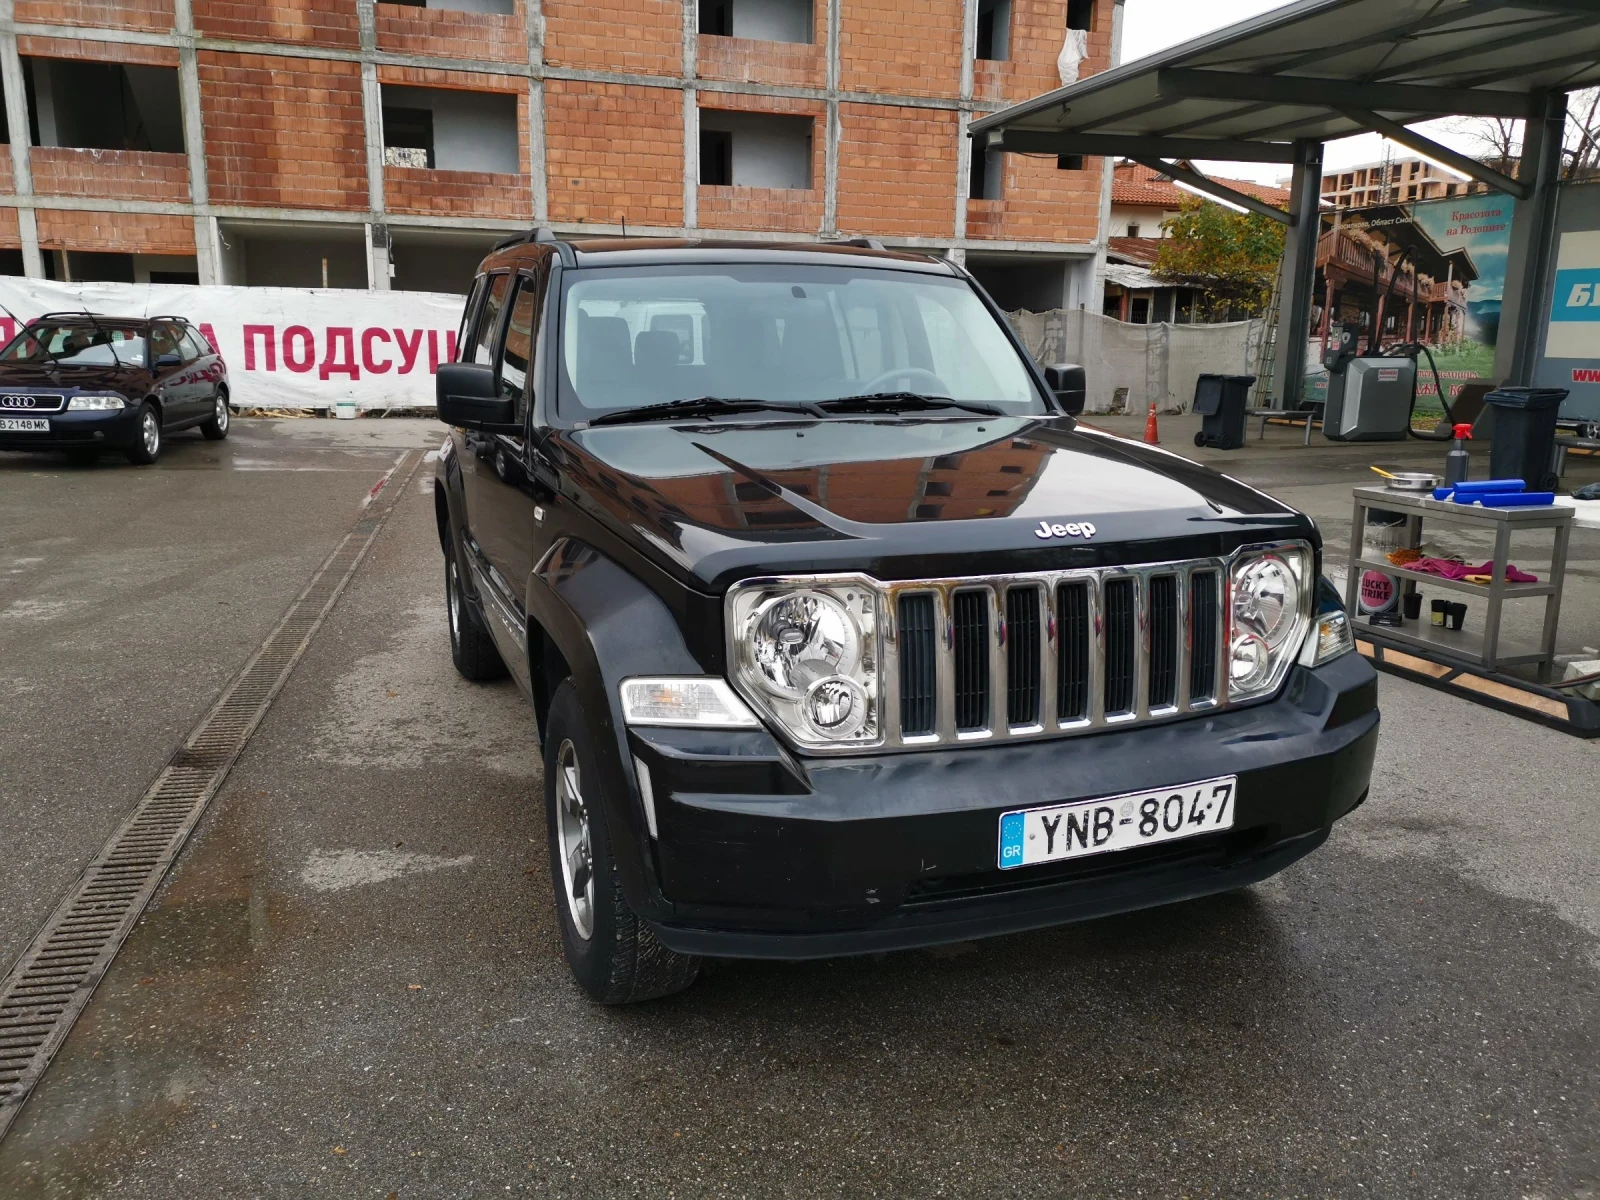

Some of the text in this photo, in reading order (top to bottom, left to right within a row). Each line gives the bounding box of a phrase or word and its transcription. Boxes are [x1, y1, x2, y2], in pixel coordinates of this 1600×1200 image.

[1452, 208, 1502, 222] Красотата
[1371, 218, 1394, 228] Област
[1446, 223, 1507, 236] на Родопите
[1034, 521, 1097, 539] Jeep
[1362, 577, 1390, 590] LUCKY
[1361, 587, 1389, 600] STRIKE
[1041, 783, 1233, 855] YNB-8047
[1002, 845, 1021, 858] GR
